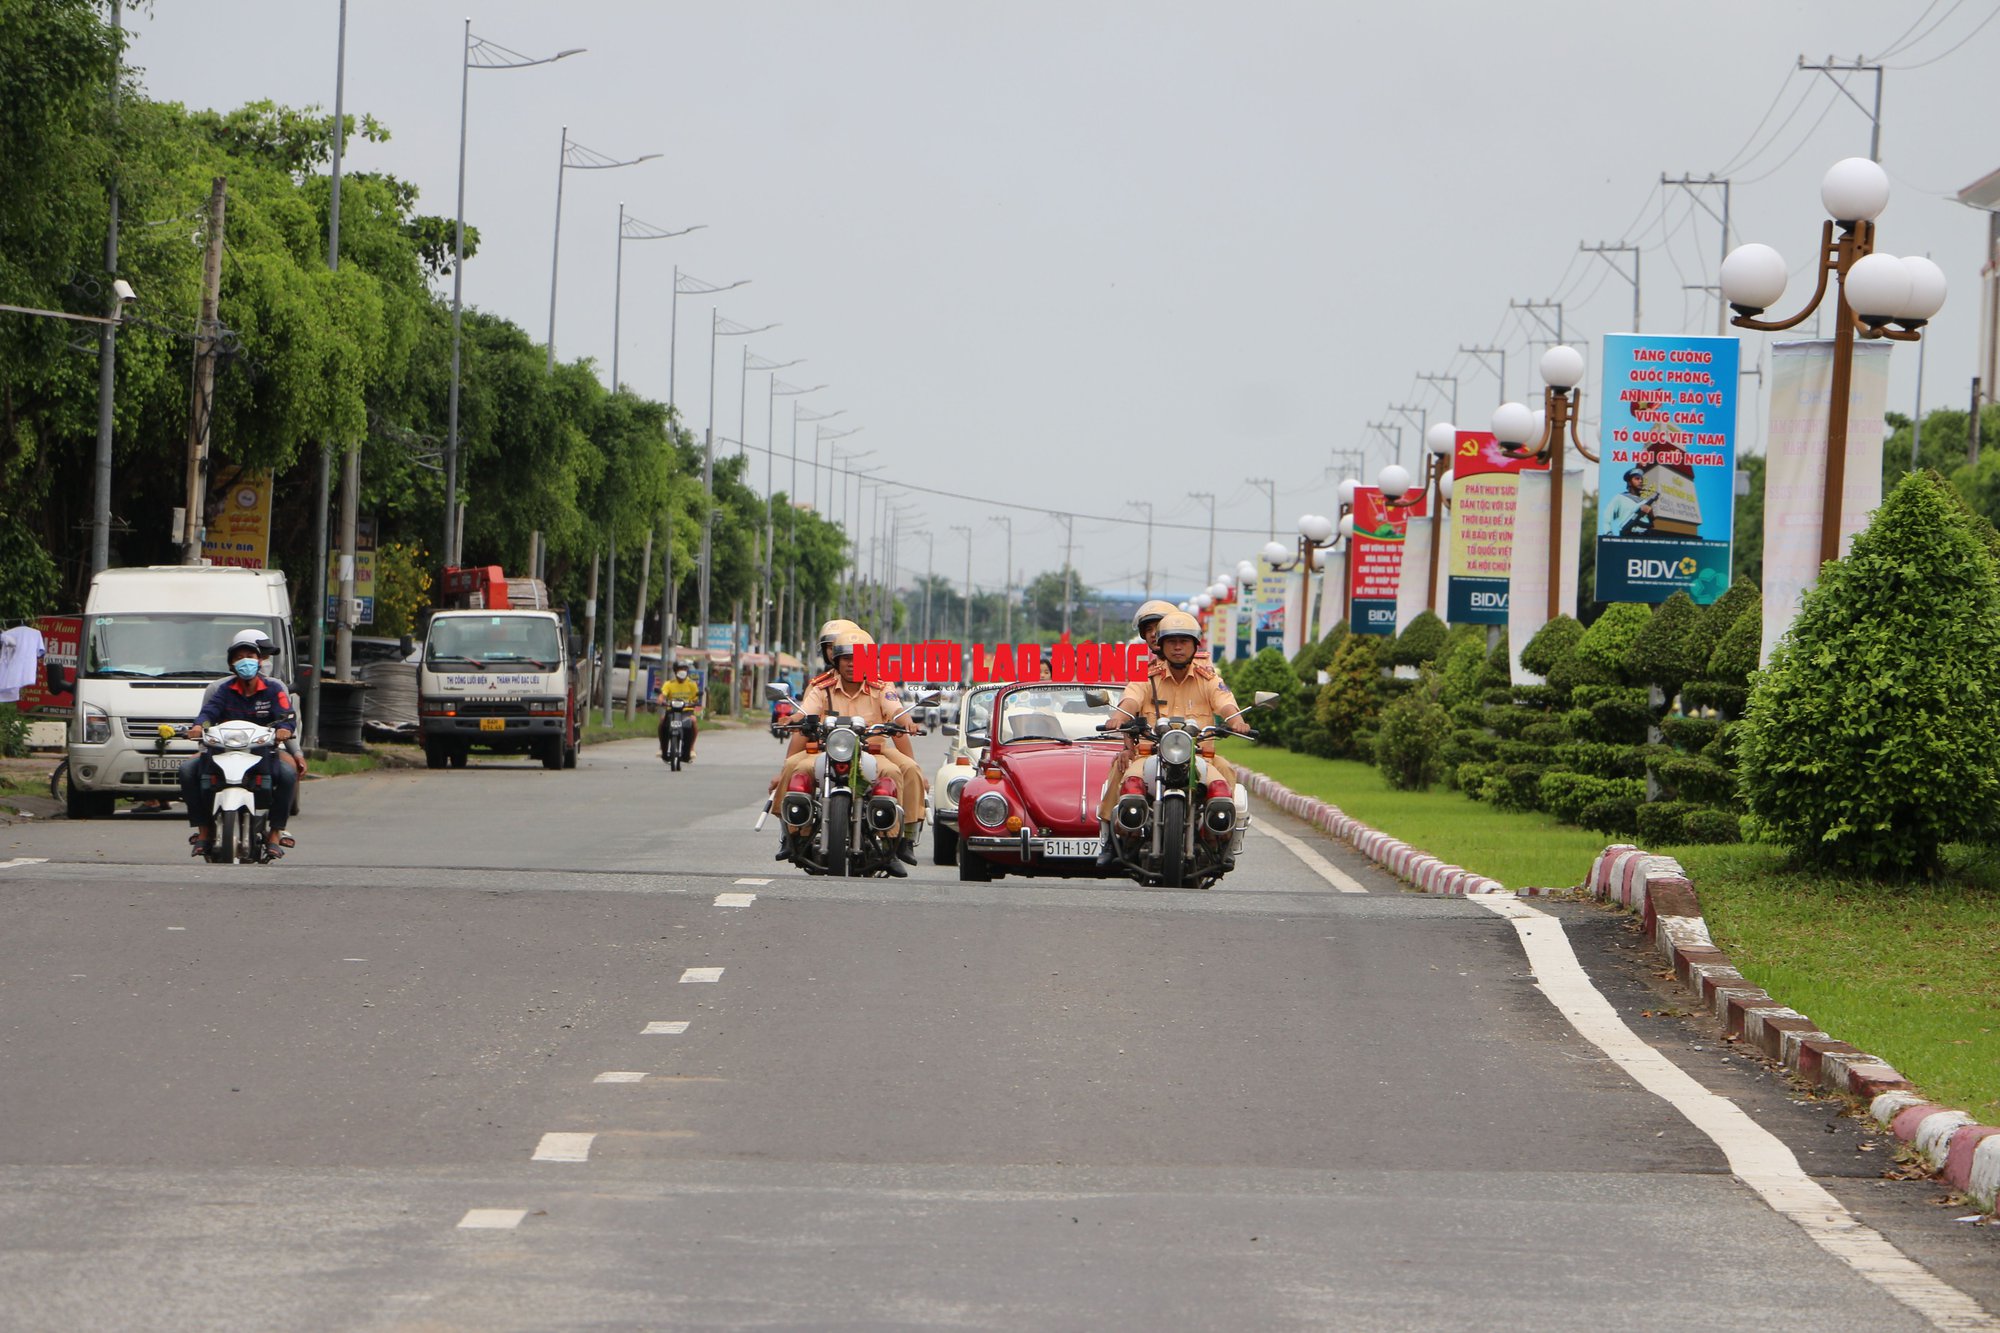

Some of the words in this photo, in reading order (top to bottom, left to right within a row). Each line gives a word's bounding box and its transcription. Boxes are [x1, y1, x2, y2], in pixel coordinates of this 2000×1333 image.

[1630, 367, 1664, 382] QUỐC
[1667, 369, 1715, 386] PHÒNG,
[1620, 389, 1637, 401] AN
[1638, 389, 1676, 405] NINH,
[1679, 389, 1704, 404] BẢO
[1707, 391, 1722, 408] VỆ
[1613, 427, 1629, 442] TỔ
[1632, 429, 1667, 443] QUỐC
[1669, 432, 1694, 446] VIỆT
[1697, 433, 1726, 445] NAM
[1612, 449, 1628, 462] XÃ
[1632, 451, 1654, 466] HỘI
[1657, 450, 1682, 464] CHỦ
[1685, 452, 1725, 466] NGHĨA
[1465, 483, 1484, 496] PHÁT
[1460, 498, 1475, 509] DÂN
[1477, 499, 1490, 512] TỘC
[1504, 515, 1515, 526] XÂ
[1498, 529, 1513, 541] VỮN
[1627, 559, 1680, 579] BIDV
[1470, 592, 1507, 607] BIDV
[1047, 841, 1098, 855] 51H-197
